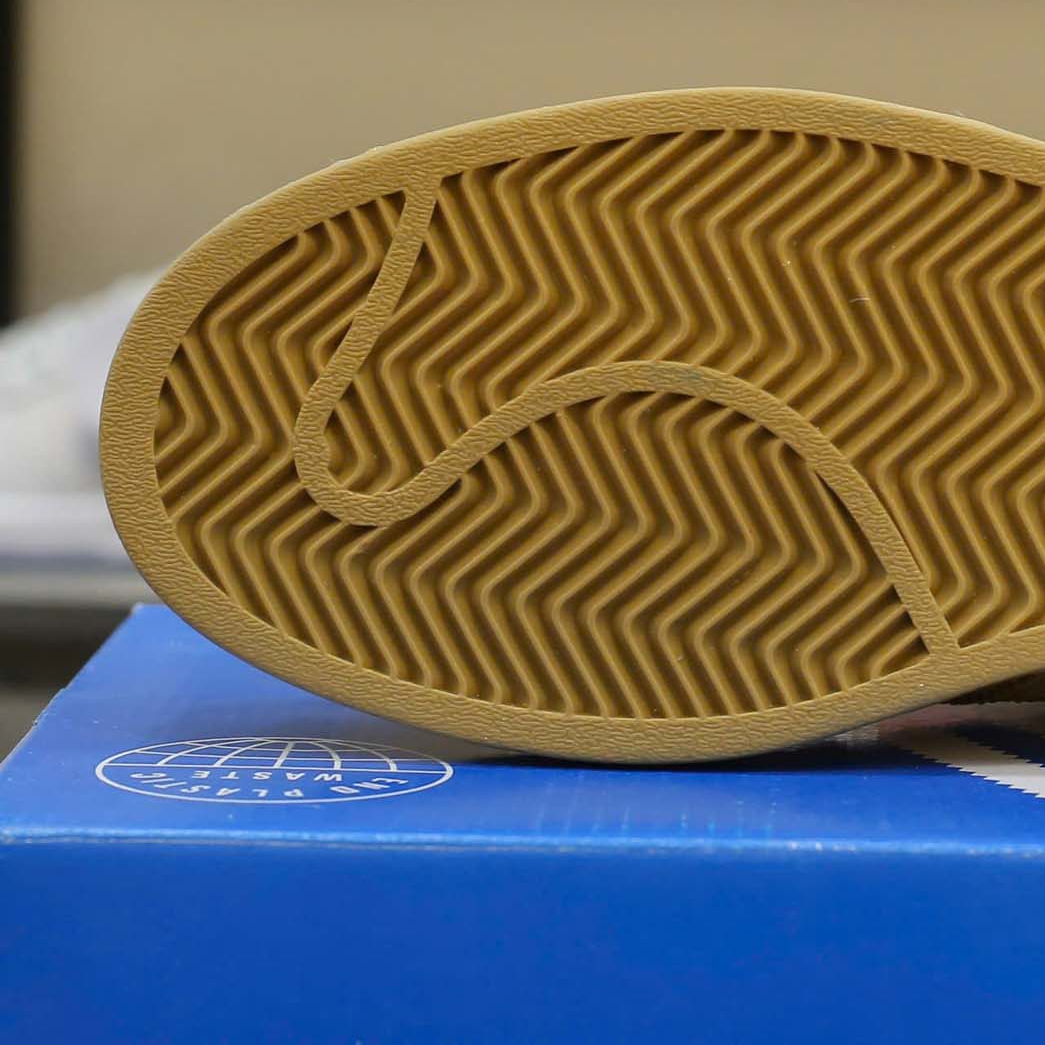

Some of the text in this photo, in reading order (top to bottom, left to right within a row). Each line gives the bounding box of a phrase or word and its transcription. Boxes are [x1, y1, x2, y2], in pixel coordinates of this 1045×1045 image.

[130, 772, 408, 798] END PLASTIC
[191, 770, 343, 782] WASTE
